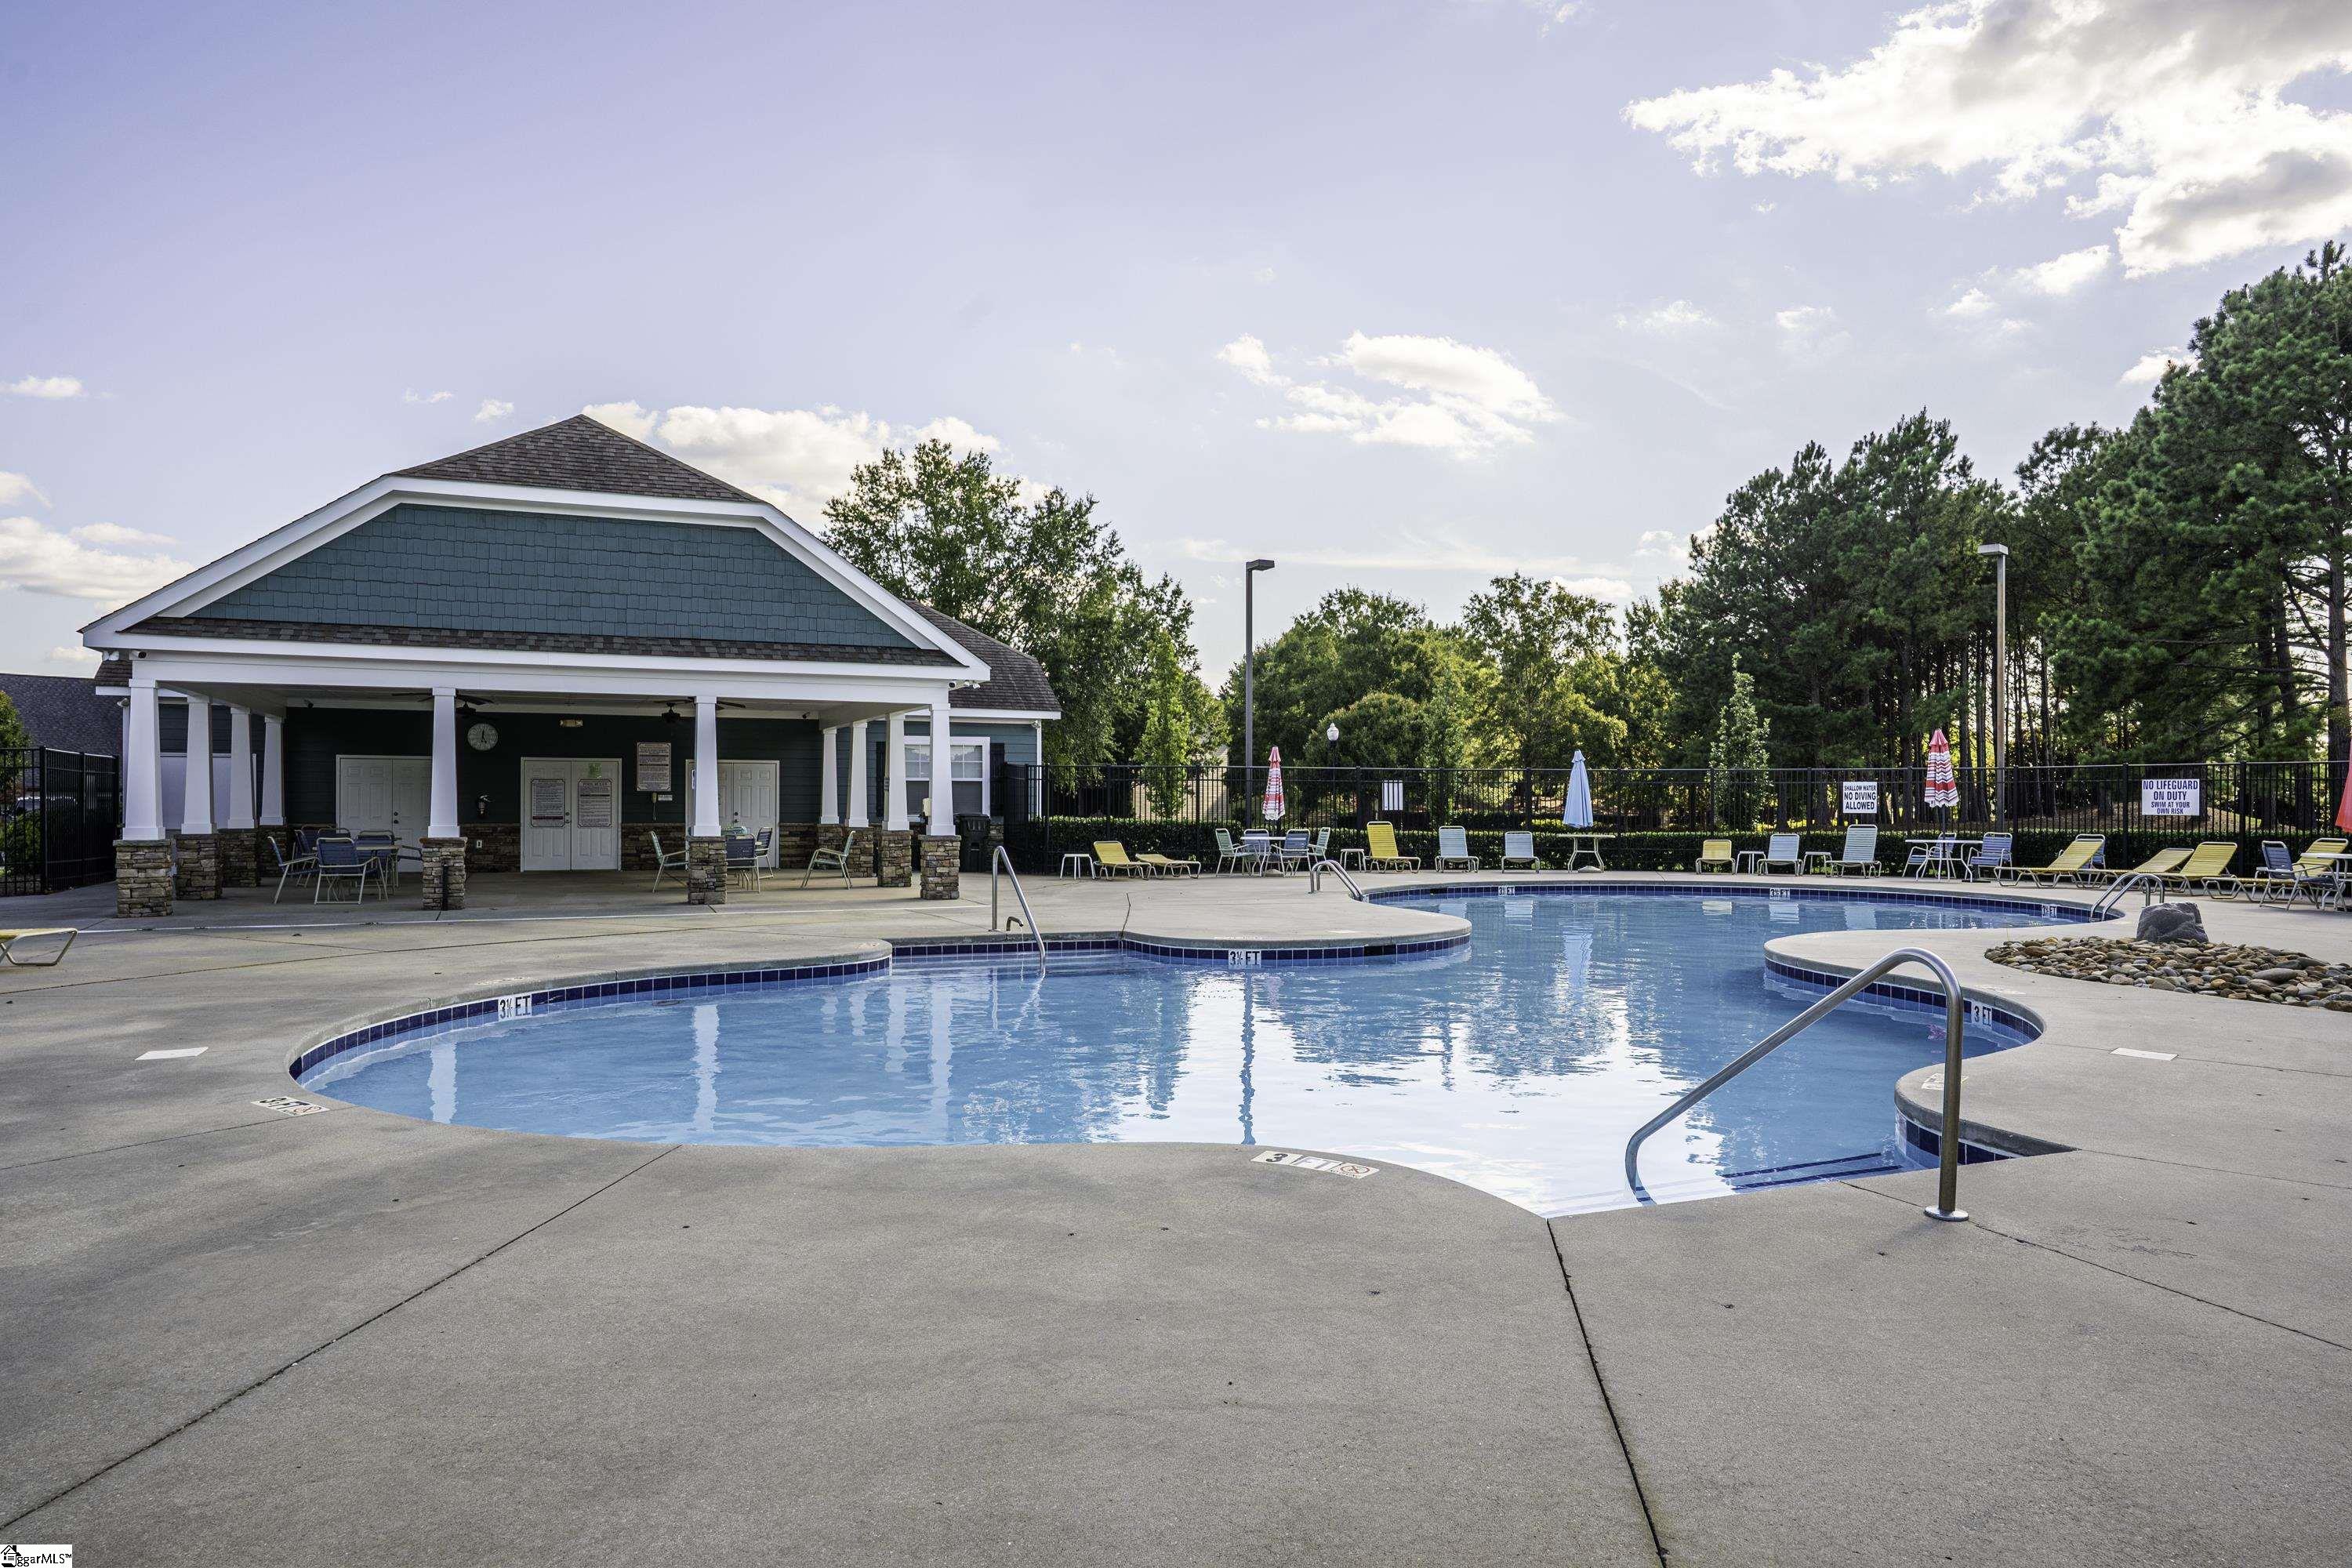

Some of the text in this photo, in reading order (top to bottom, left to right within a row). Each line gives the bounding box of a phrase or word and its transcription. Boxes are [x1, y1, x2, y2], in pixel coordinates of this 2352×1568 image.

[2143, 780, 2198, 789] NO LIFEGUARD
[1844, 792, 1876, 800] NO DIVING
[2154, 791, 2187, 800] ON DUTY
[1845, 801, 1875, 810] ALLOWED
[1245, 951, 1260, 965] FT
[1265, 1153, 1338, 1169] 3 FT
